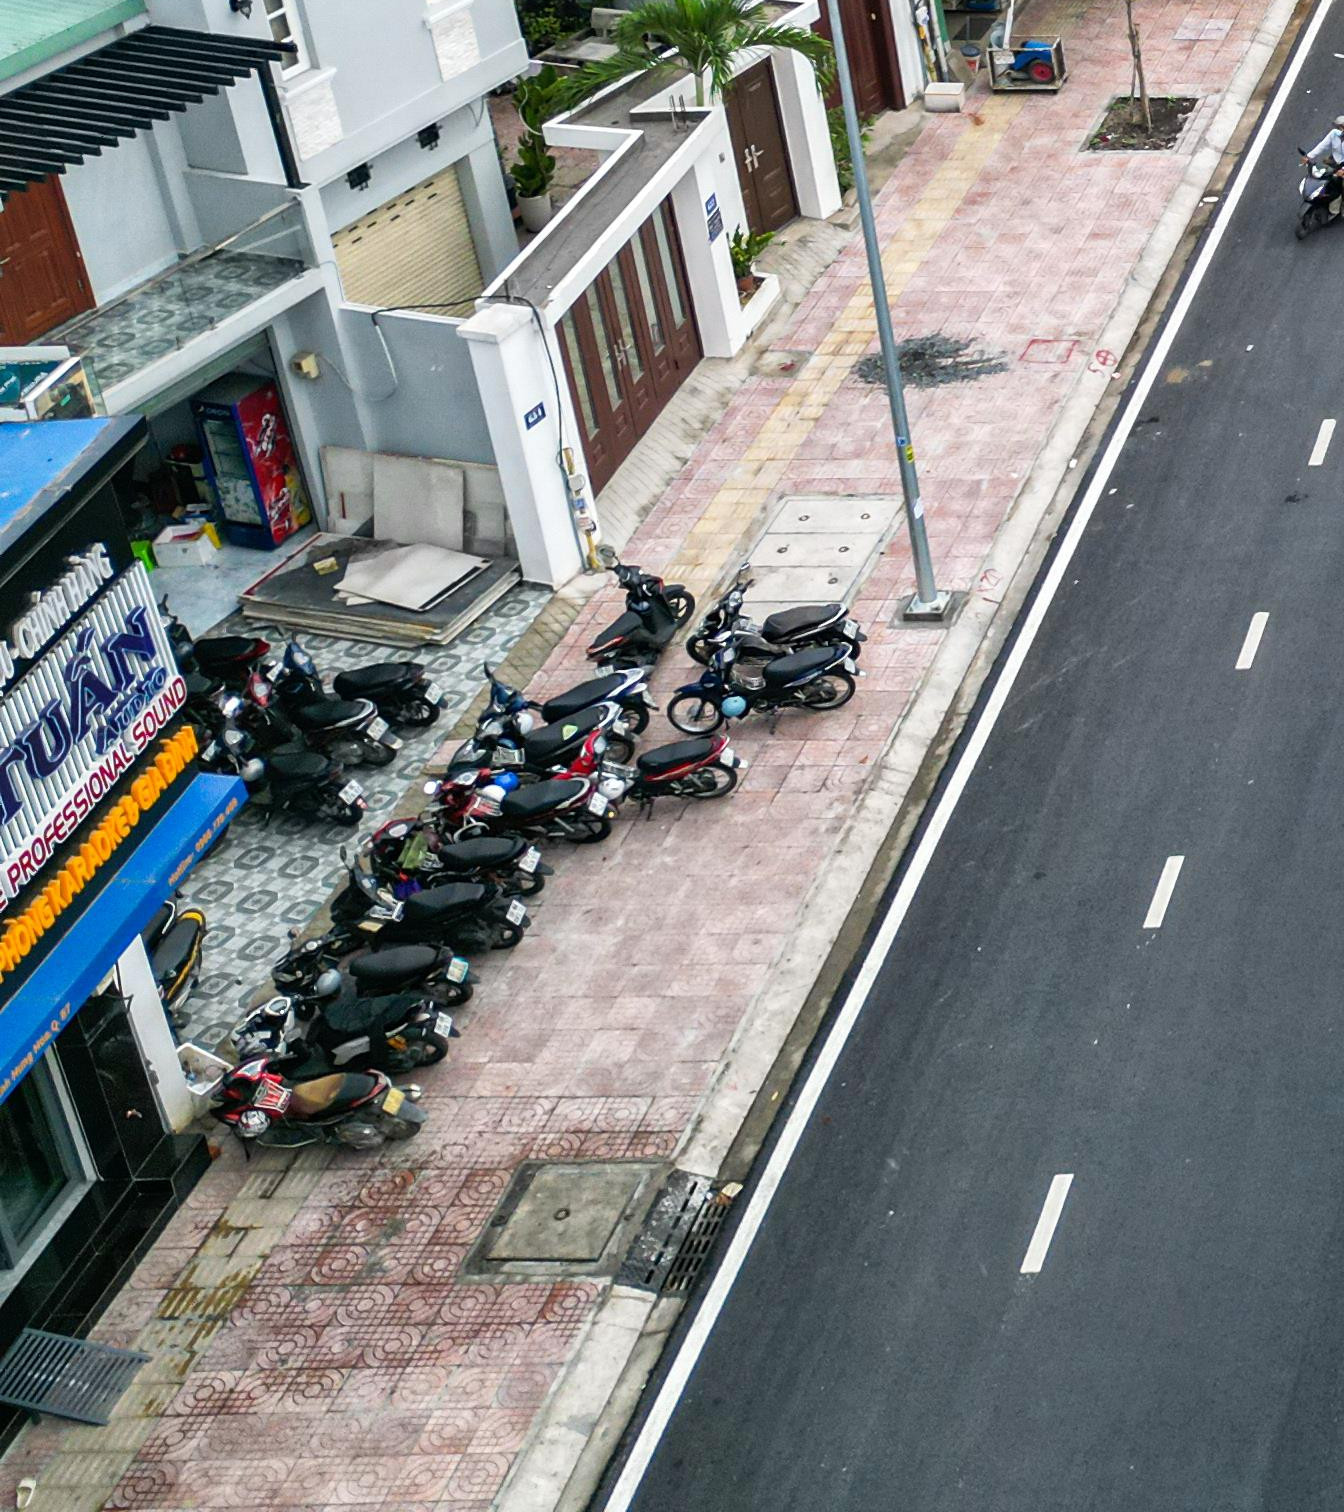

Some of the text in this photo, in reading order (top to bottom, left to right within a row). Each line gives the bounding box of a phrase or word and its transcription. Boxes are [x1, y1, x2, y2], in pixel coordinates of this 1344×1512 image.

[7, 676, 187, 886] PROFESSIONAL SOUND
[47, 807, 131, 916] KARAOKE
[131, 766, 168, 810] GIA
